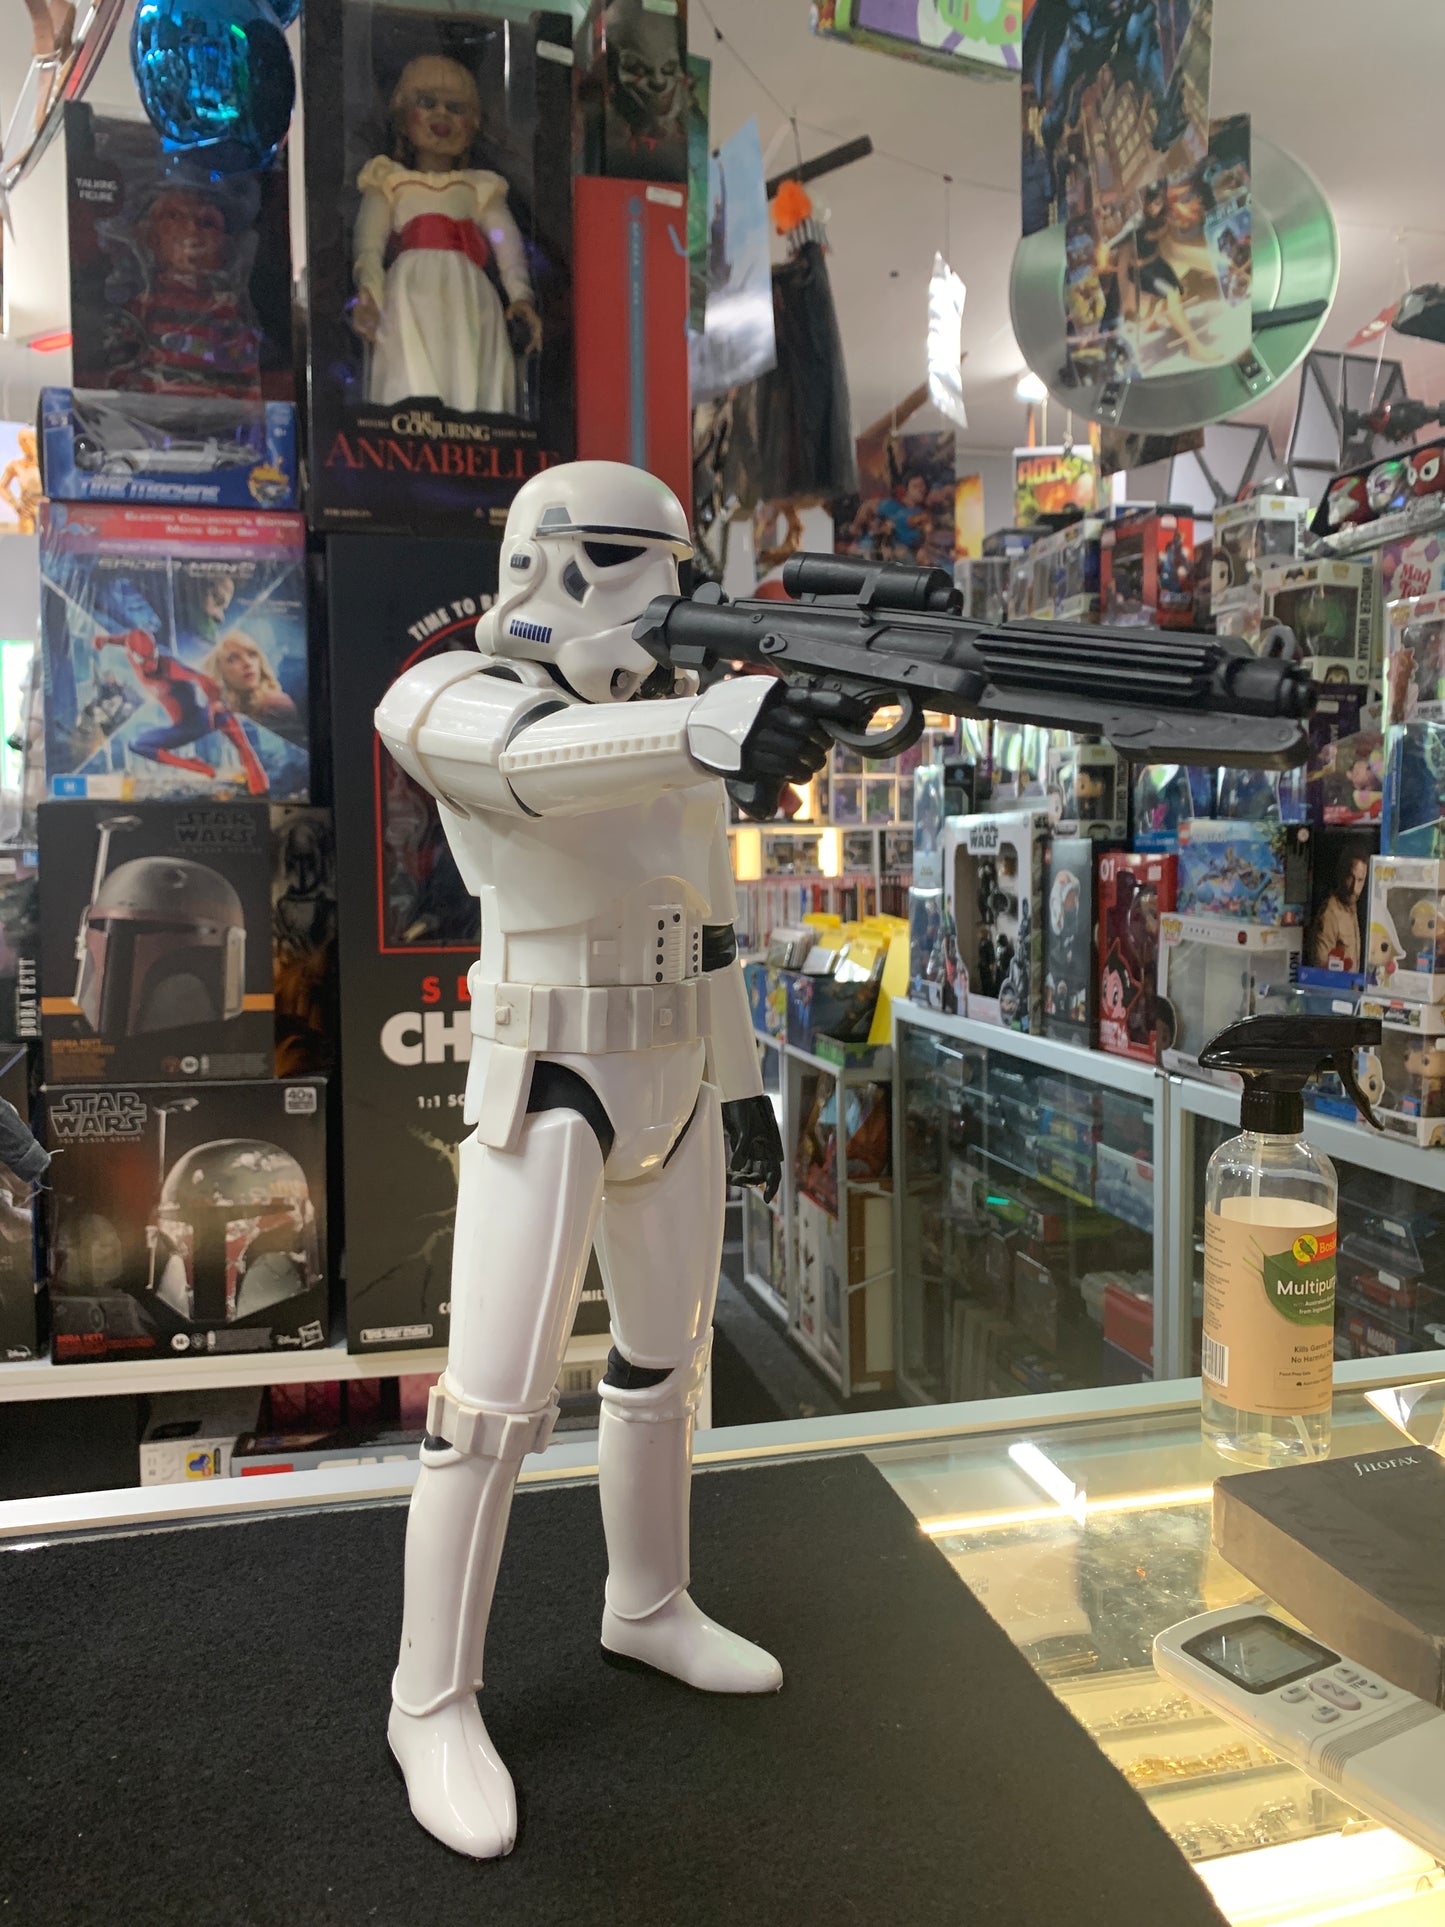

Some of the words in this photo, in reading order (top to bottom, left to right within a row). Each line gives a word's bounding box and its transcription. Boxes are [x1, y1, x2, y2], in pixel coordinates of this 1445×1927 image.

[391, 413, 491, 441] CONJURING
[407, 607, 451, 642] TIME
[450, 597, 476, 619] TO
[969, 833, 999, 849] WARS
[18, 957, 37, 995] FETT
[20, 999, 37, 1035] BOBA
[50, 1092, 147, 1115] STAR
[418, 1095, 441, 1109] 1:1
[51, 1112, 147, 1137] WARS
[1291, 1356, 1302, 1364] No
